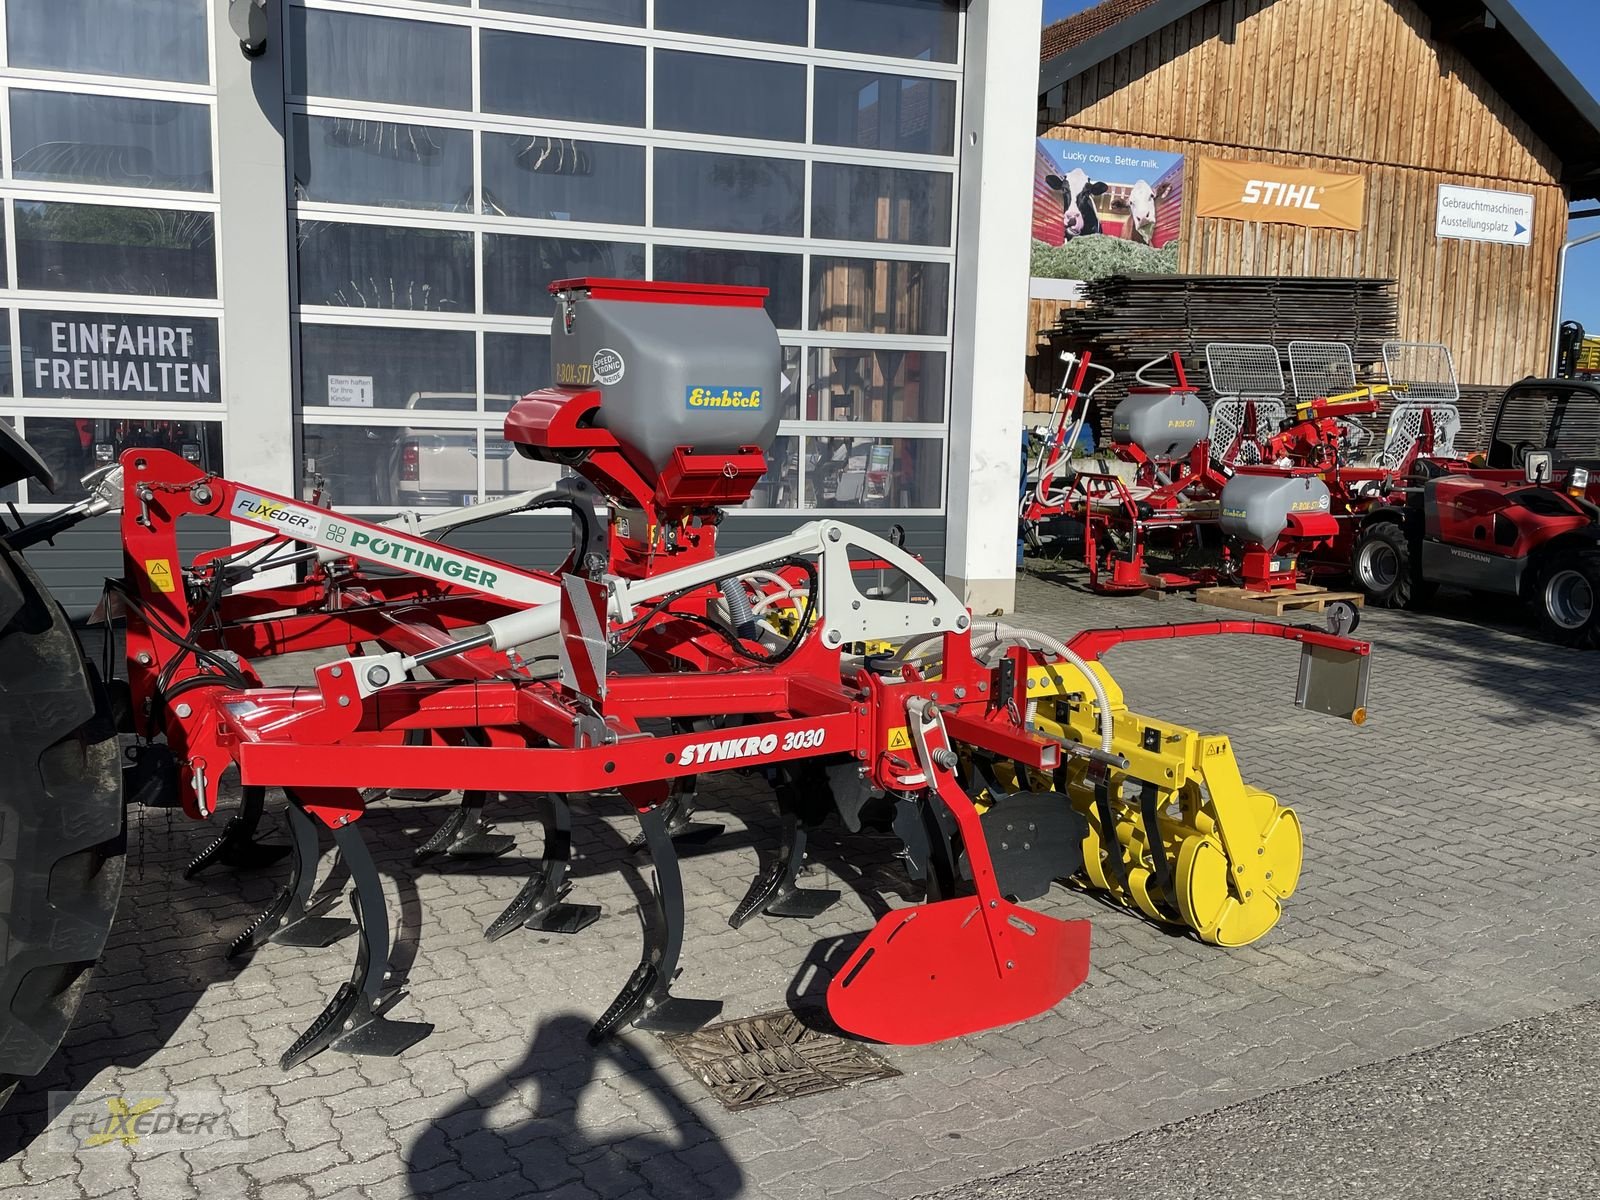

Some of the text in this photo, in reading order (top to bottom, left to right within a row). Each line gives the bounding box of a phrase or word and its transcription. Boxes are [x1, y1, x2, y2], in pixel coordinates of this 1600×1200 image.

[1062, 149, 1160, 169] Lucky cows. Better milk.
[1440, 215, 1509, 233] Ausstellungsplatz
[51, 322, 192, 357] EINFAHRT
[593, 355, 616, 369] SPEED-
[597, 361, 621, 375] TRONIC
[34, 358, 210, 394] FREIHALTEN
[330, 377, 349, 385] Eltern
[602, 372, 621, 384] INSIDE
[689, 388, 761, 408] Einböck
[1450, 548, 1491, 564] WEIDEMANN
[678, 727, 826, 766] SYNKRO 3030
